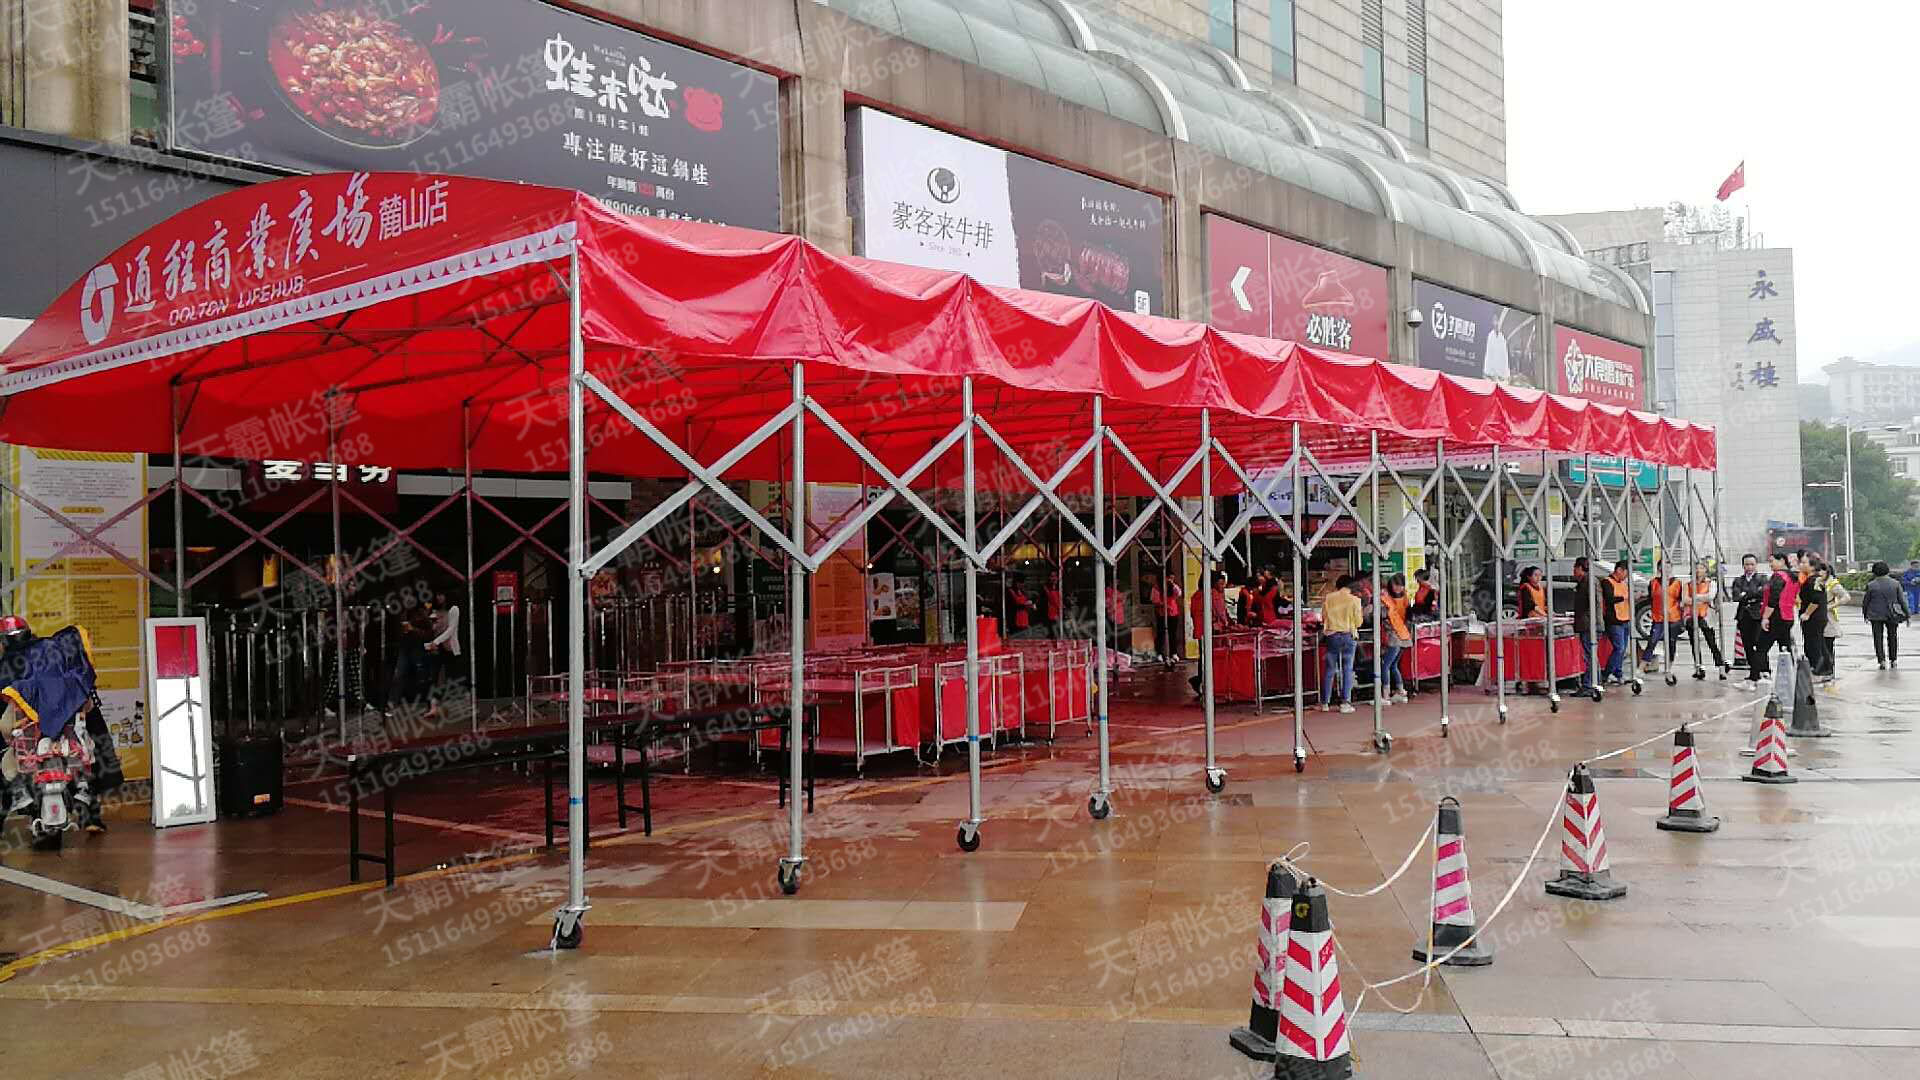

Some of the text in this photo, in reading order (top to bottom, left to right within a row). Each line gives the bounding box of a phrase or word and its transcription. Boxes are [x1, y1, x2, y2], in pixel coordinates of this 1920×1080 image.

[378, 179, 449, 241] 麓山店
[892, 200, 993, 249] 豪客来牛排
[237, 275, 304, 309] LIFEHUB
[1306, 313, 1352, 350] 必胜客
